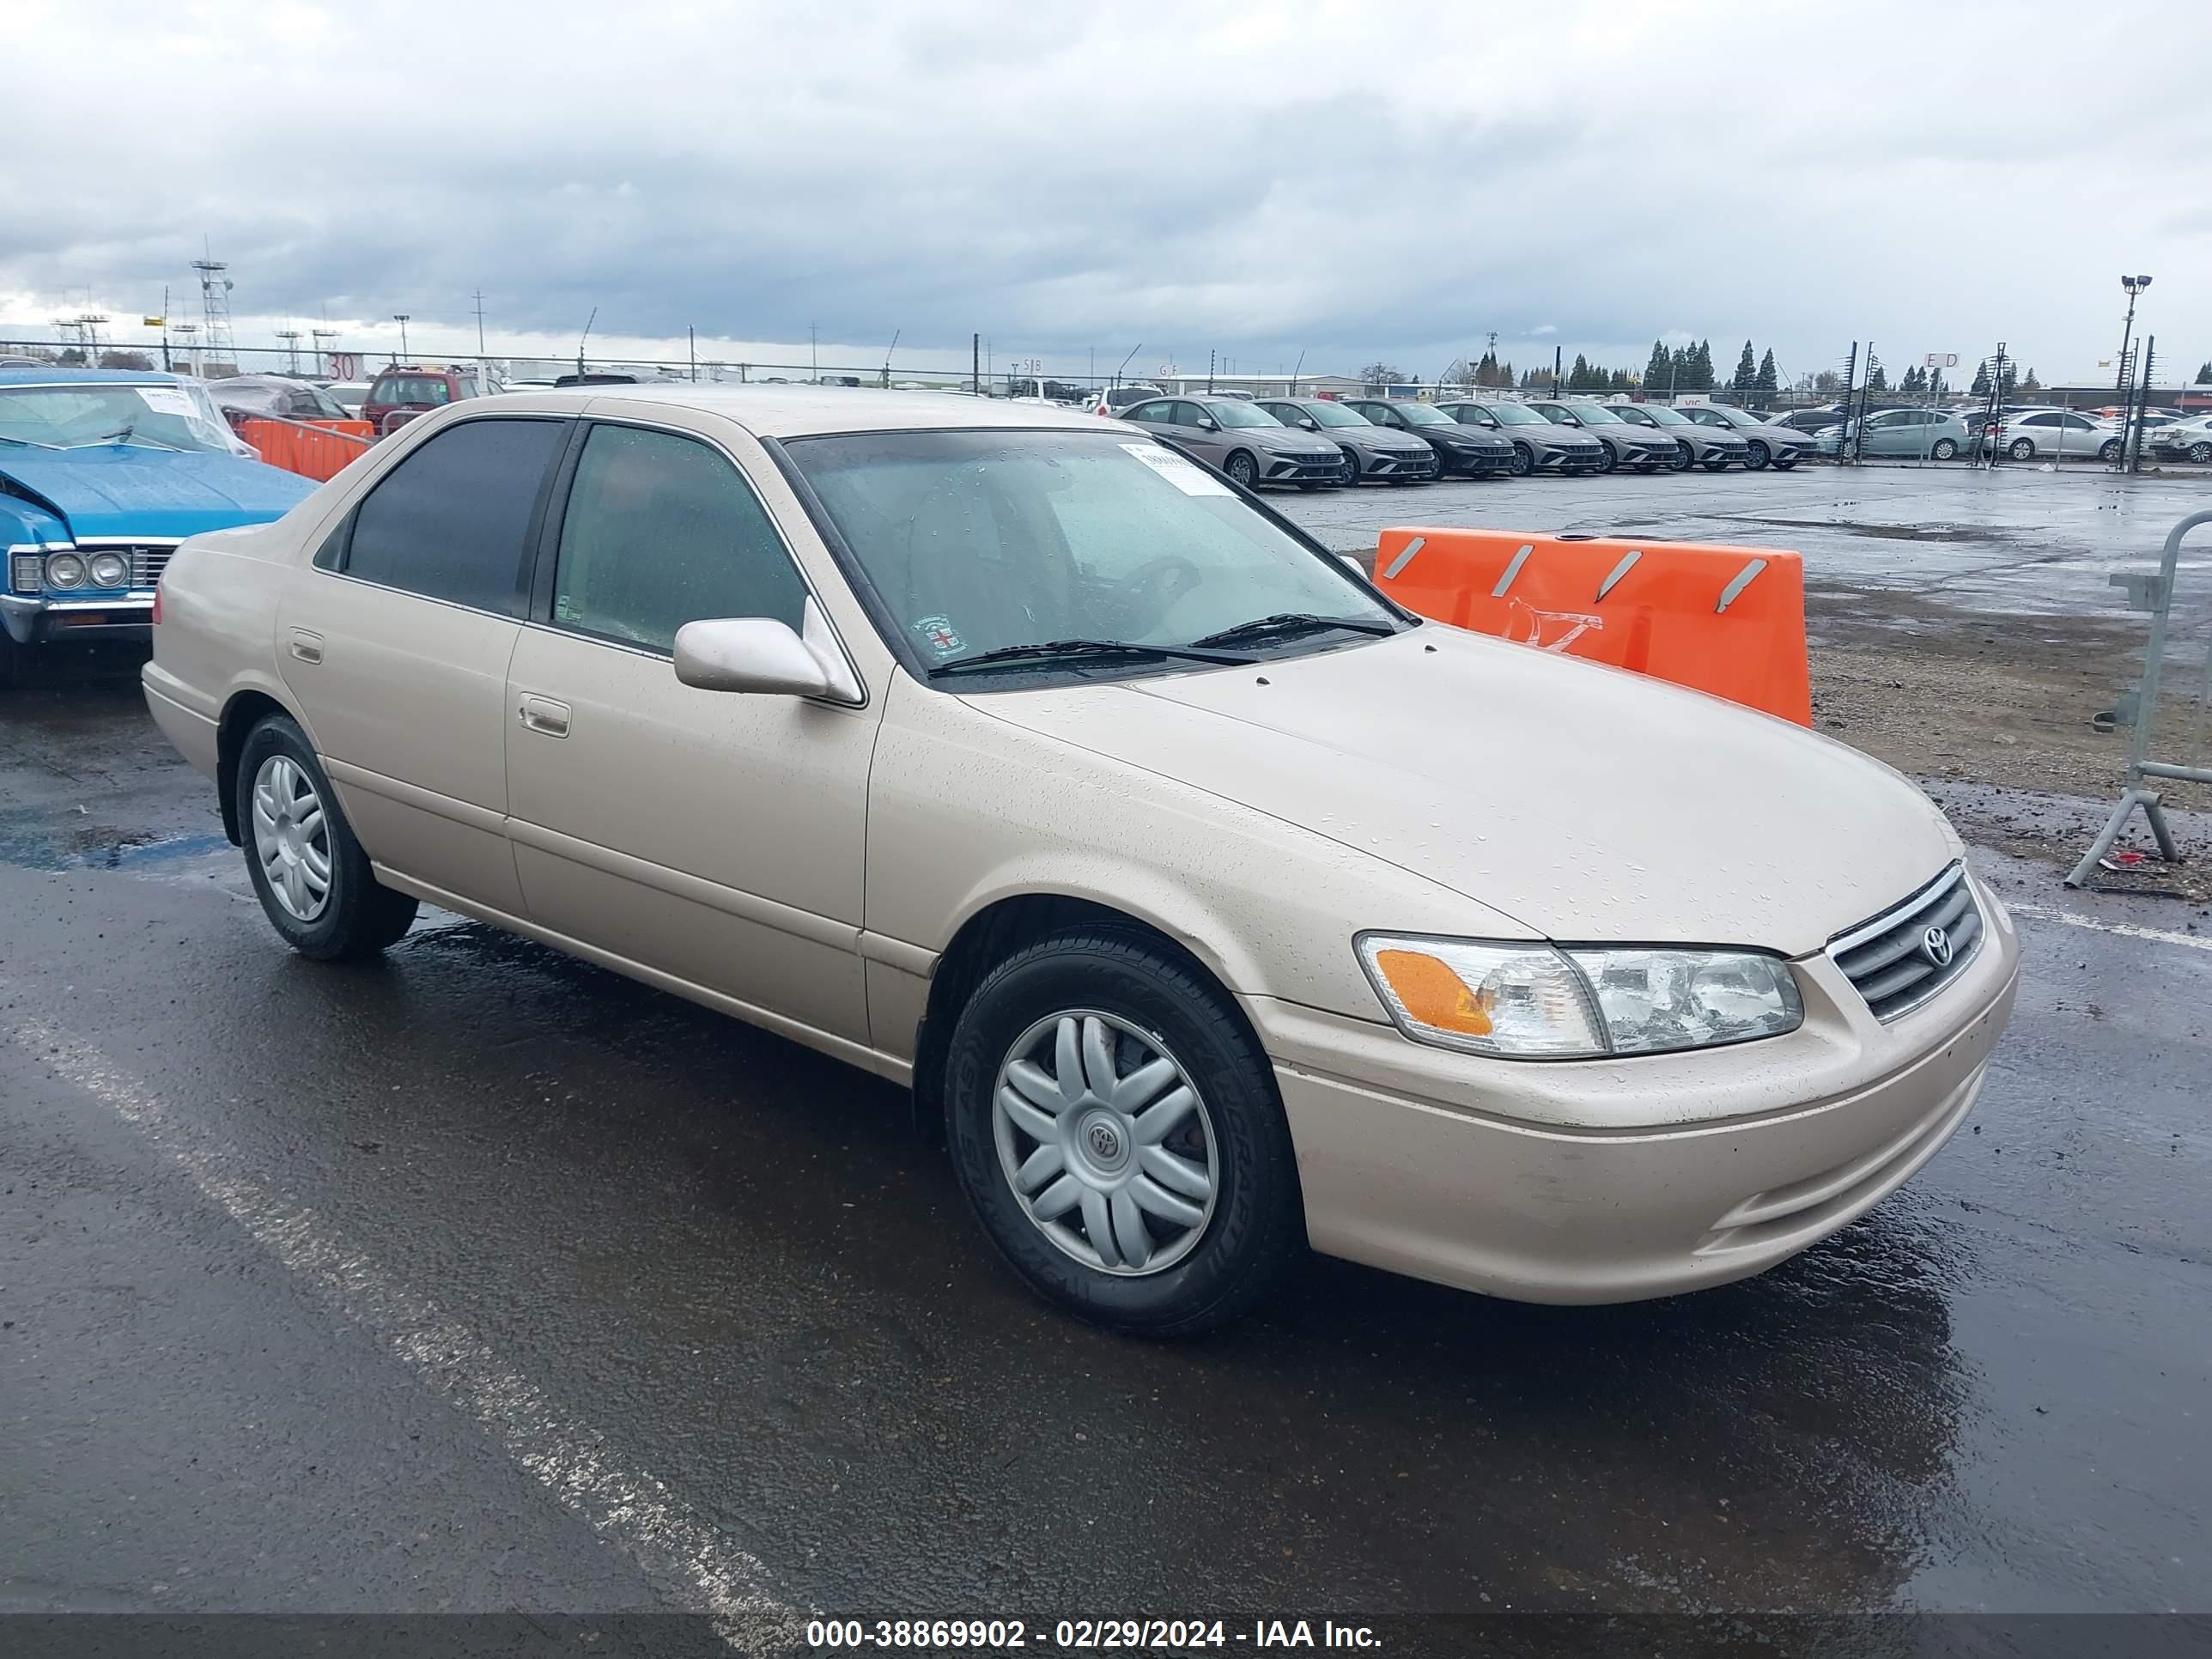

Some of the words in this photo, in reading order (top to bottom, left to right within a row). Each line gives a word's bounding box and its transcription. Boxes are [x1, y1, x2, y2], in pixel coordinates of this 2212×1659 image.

[330, 354, 354, 380] 30
[1927, 353, 1936, 368] E
[1946, 353, 1958, 368] D
